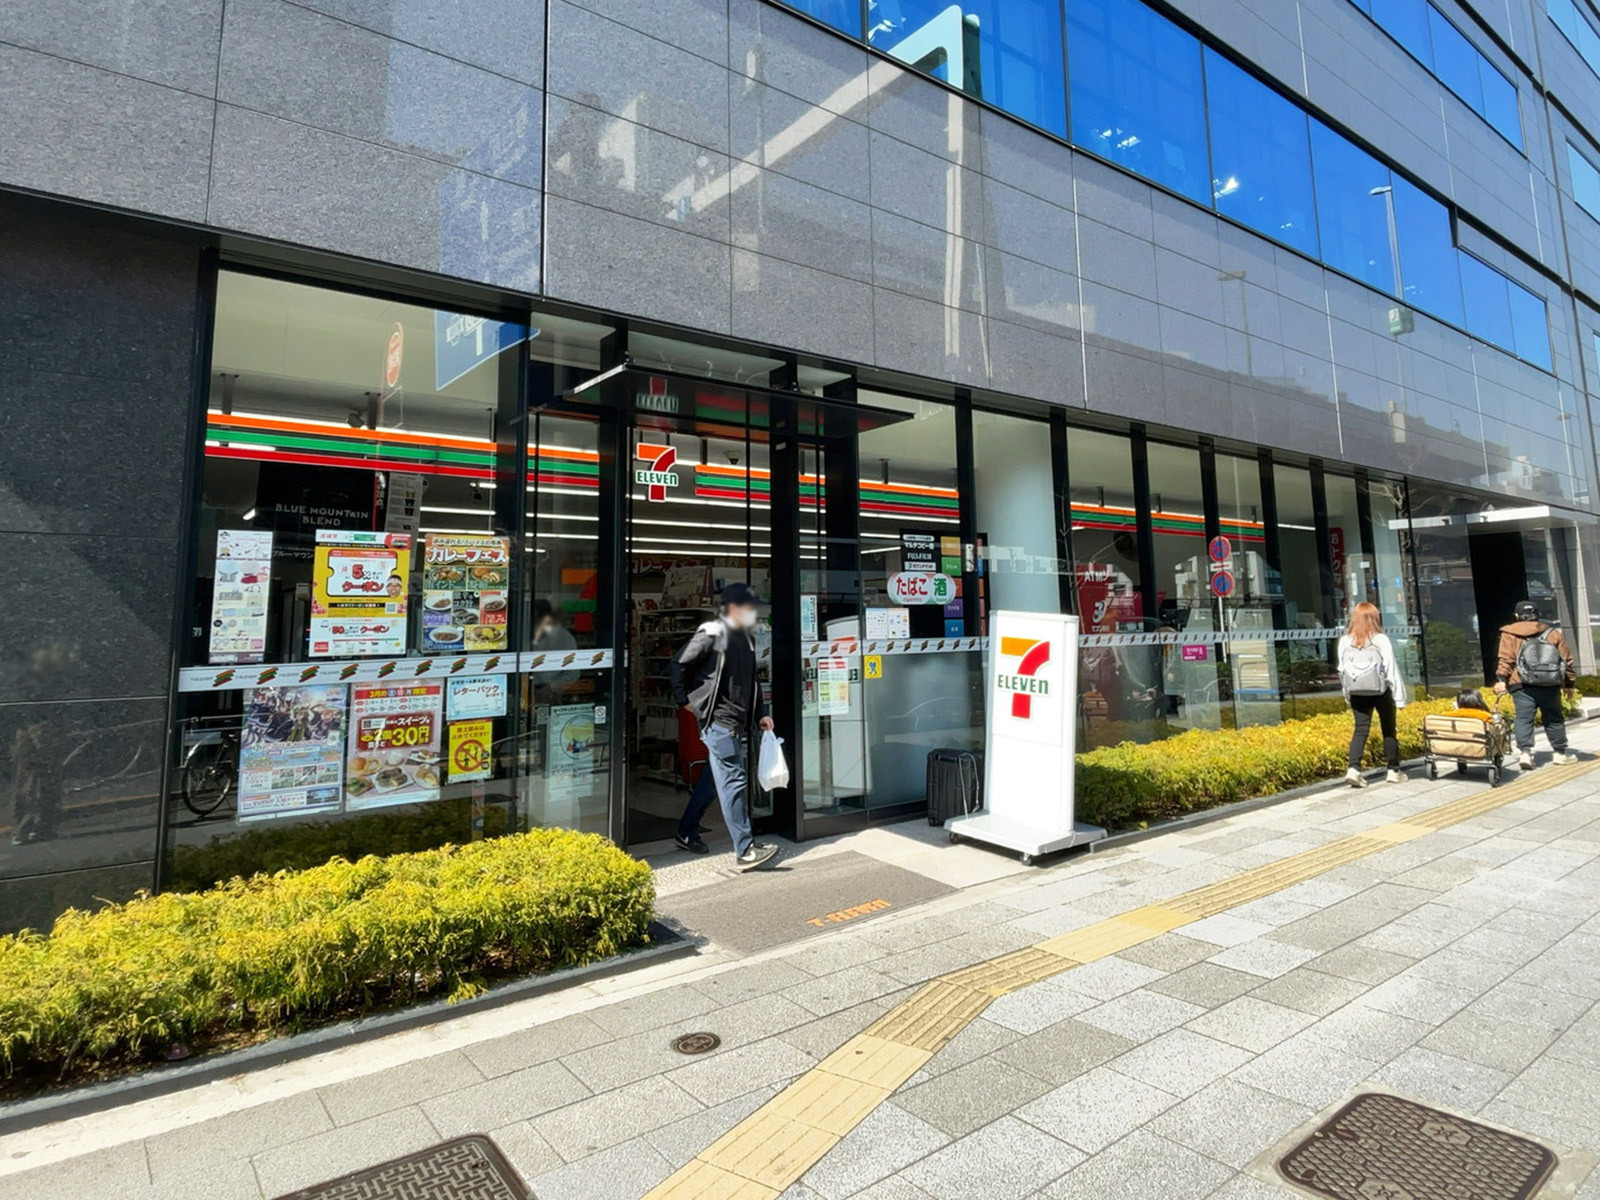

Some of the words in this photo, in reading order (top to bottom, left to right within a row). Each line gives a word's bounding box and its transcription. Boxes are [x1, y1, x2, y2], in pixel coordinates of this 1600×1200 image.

[275, 503, 306, 515] BLUE
[310, 506, 369, 519] MOUNTAIN
[302, 516, 341, 527] BLEND
[426, 547, 508, 563] カレーフェス
[1084, 571, 1104, 582] ATM
[896, 577, 928, 596] たばこ
[934, 578, 947, 596] 酒
[1001, 635, 1050, 719] 7
[453, 685, 500, 696] レターパック
